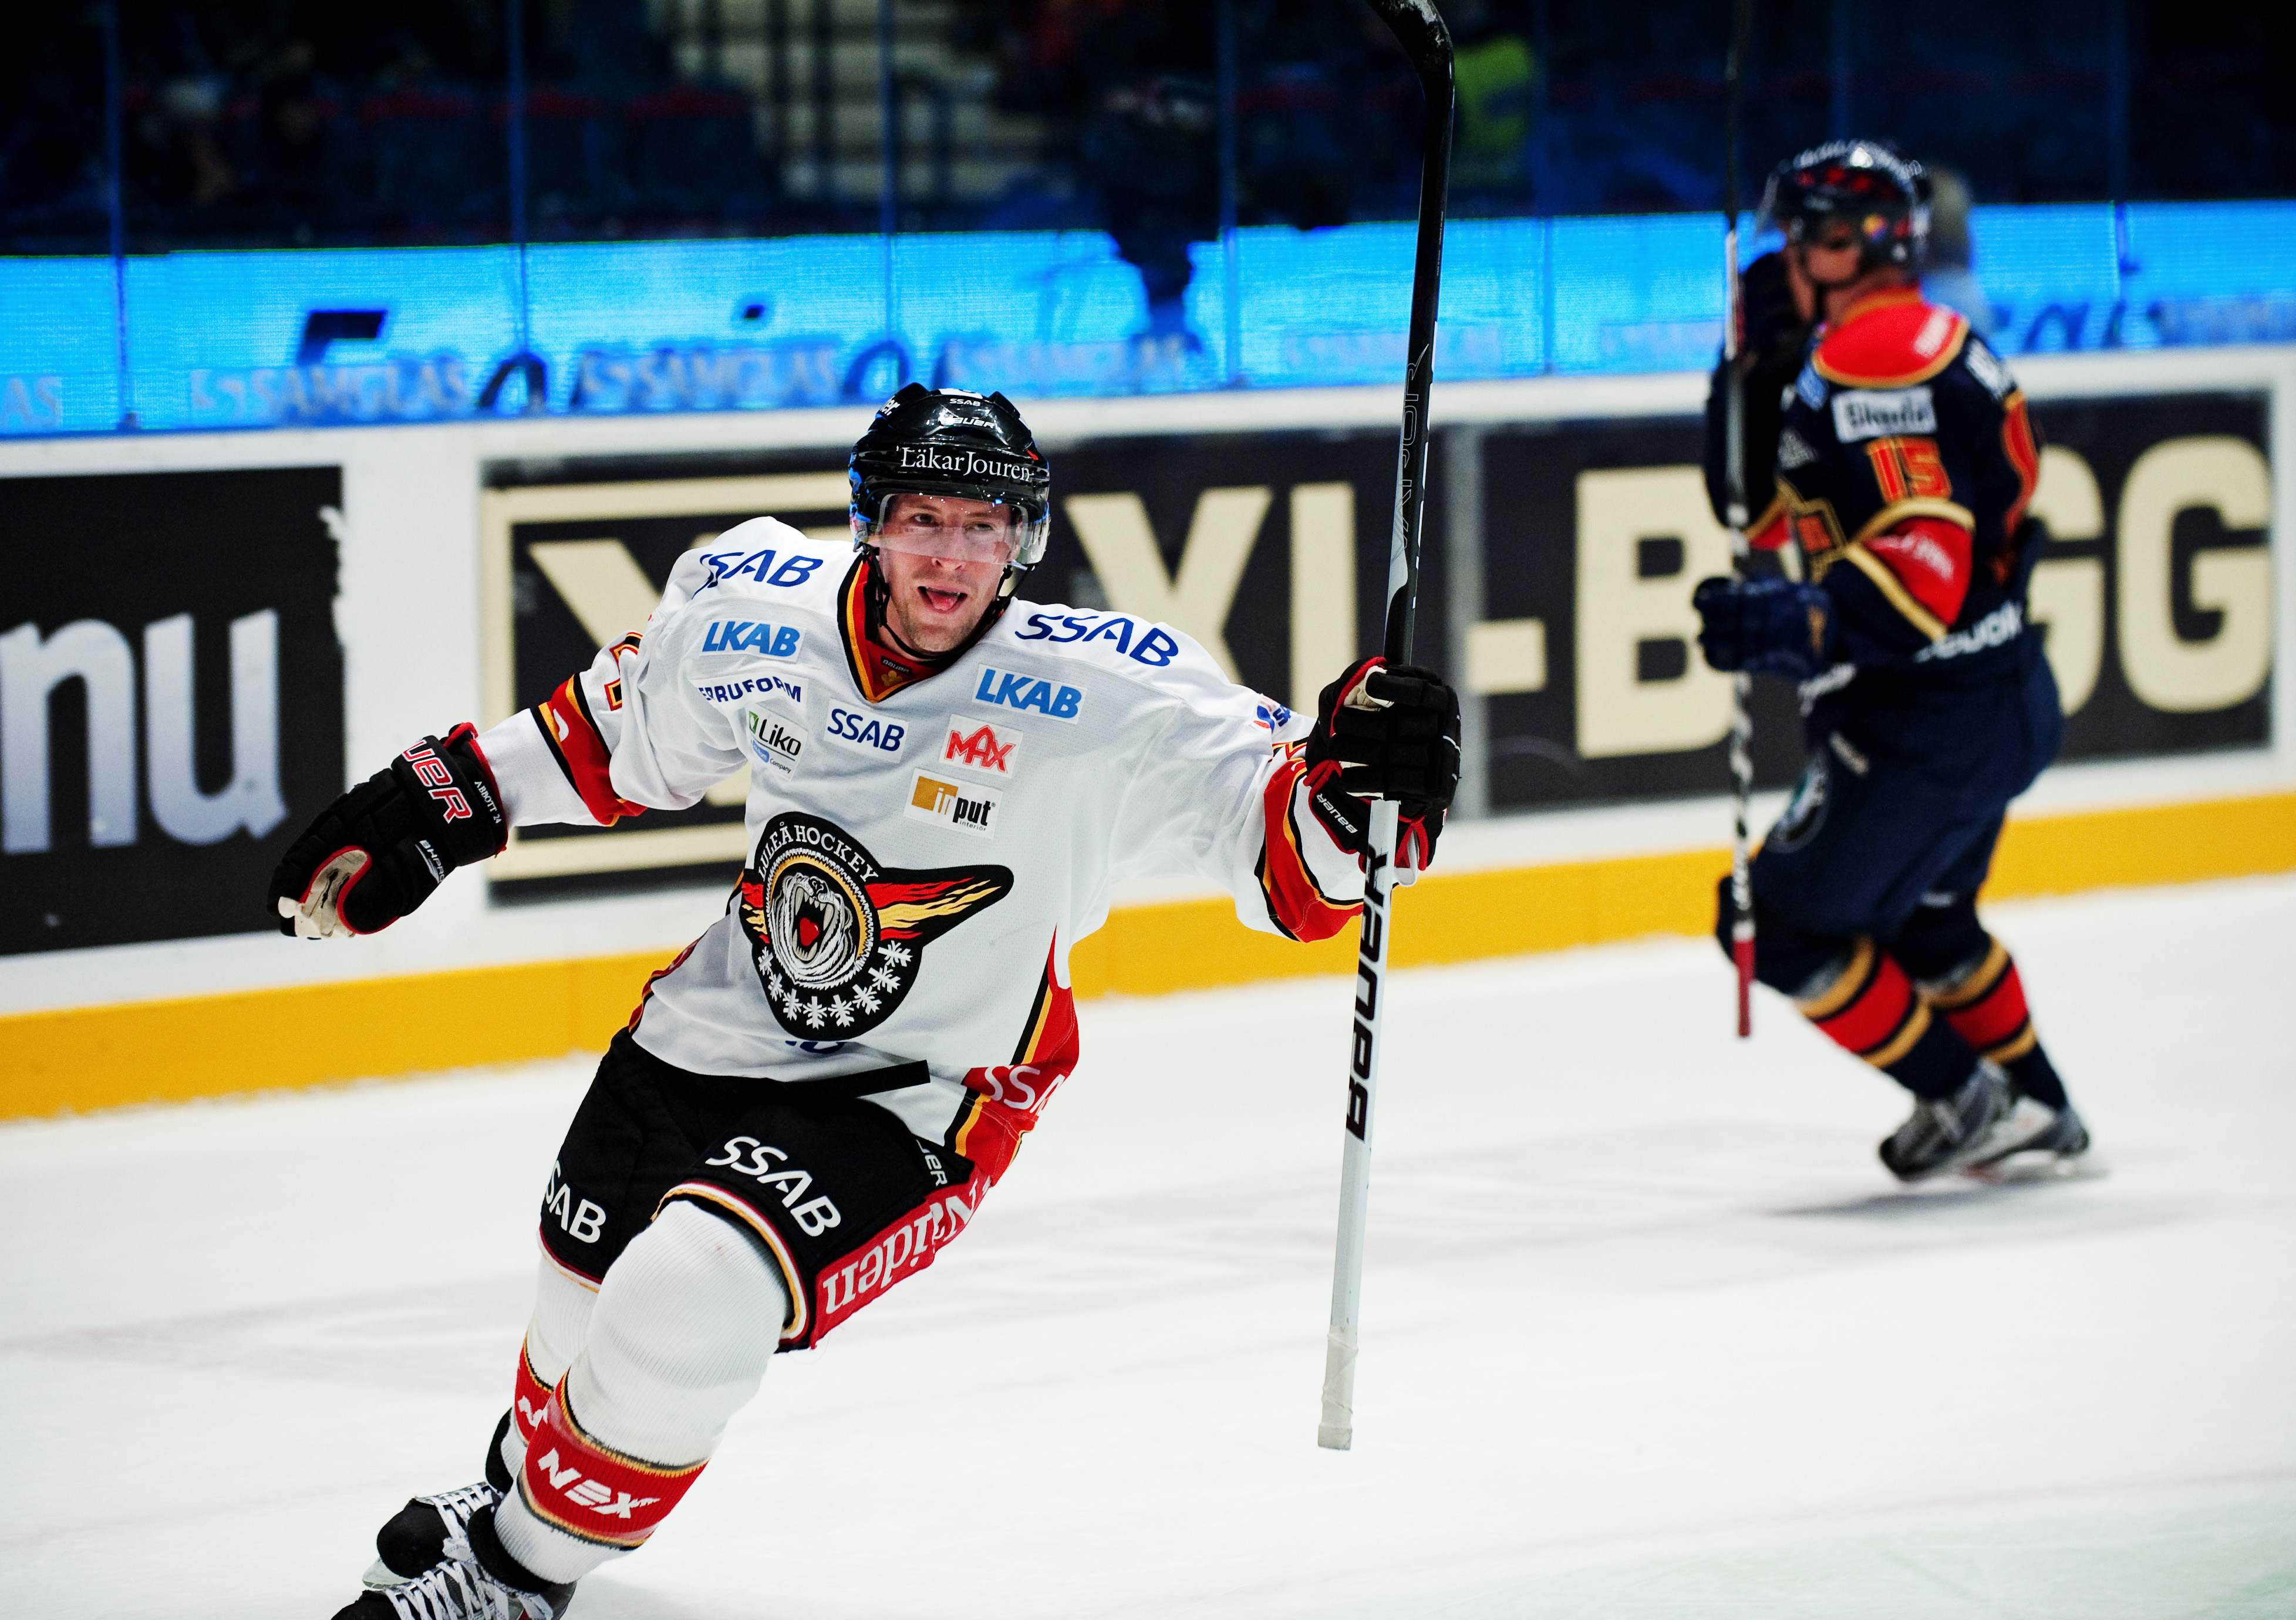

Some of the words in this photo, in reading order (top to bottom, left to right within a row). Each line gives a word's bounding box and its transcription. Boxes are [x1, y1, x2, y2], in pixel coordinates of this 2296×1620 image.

[949, 399, 981, 407] SSAB
[901, 446, 1030, 482] LäkarJouren
[1867, 436, 1953, 503] 15
[1063, 434, 2272, 760] XL-BGG
[702, 621, 801, 657] LKAB
[1014, 613, 1179, 667] SSAB
[975, 669, 1083, 719] LKAB
[0, 608, 288, 855] nu
[758, 718, 801, 756] Liko
[828, 708, 905, 752] SSAB
[944, 724, 1016, 774] MAX
[770, 758, 791, 774] Company
[474, 781, 497, 813] ABBOTT
[493, 813, 502, 824] 24
[932, 787, 992, 826] input
[1316, 793, 1358, 834] BAUER
[758, 822, 794, 882] LULEÅ
[794, 825, 879, 883] HOCKEY
[1346, 843, 1388, 1142] BAUER
[705, 1136, 842, 1237] SSAB
[538, 1447, 660, 1519] NEX
